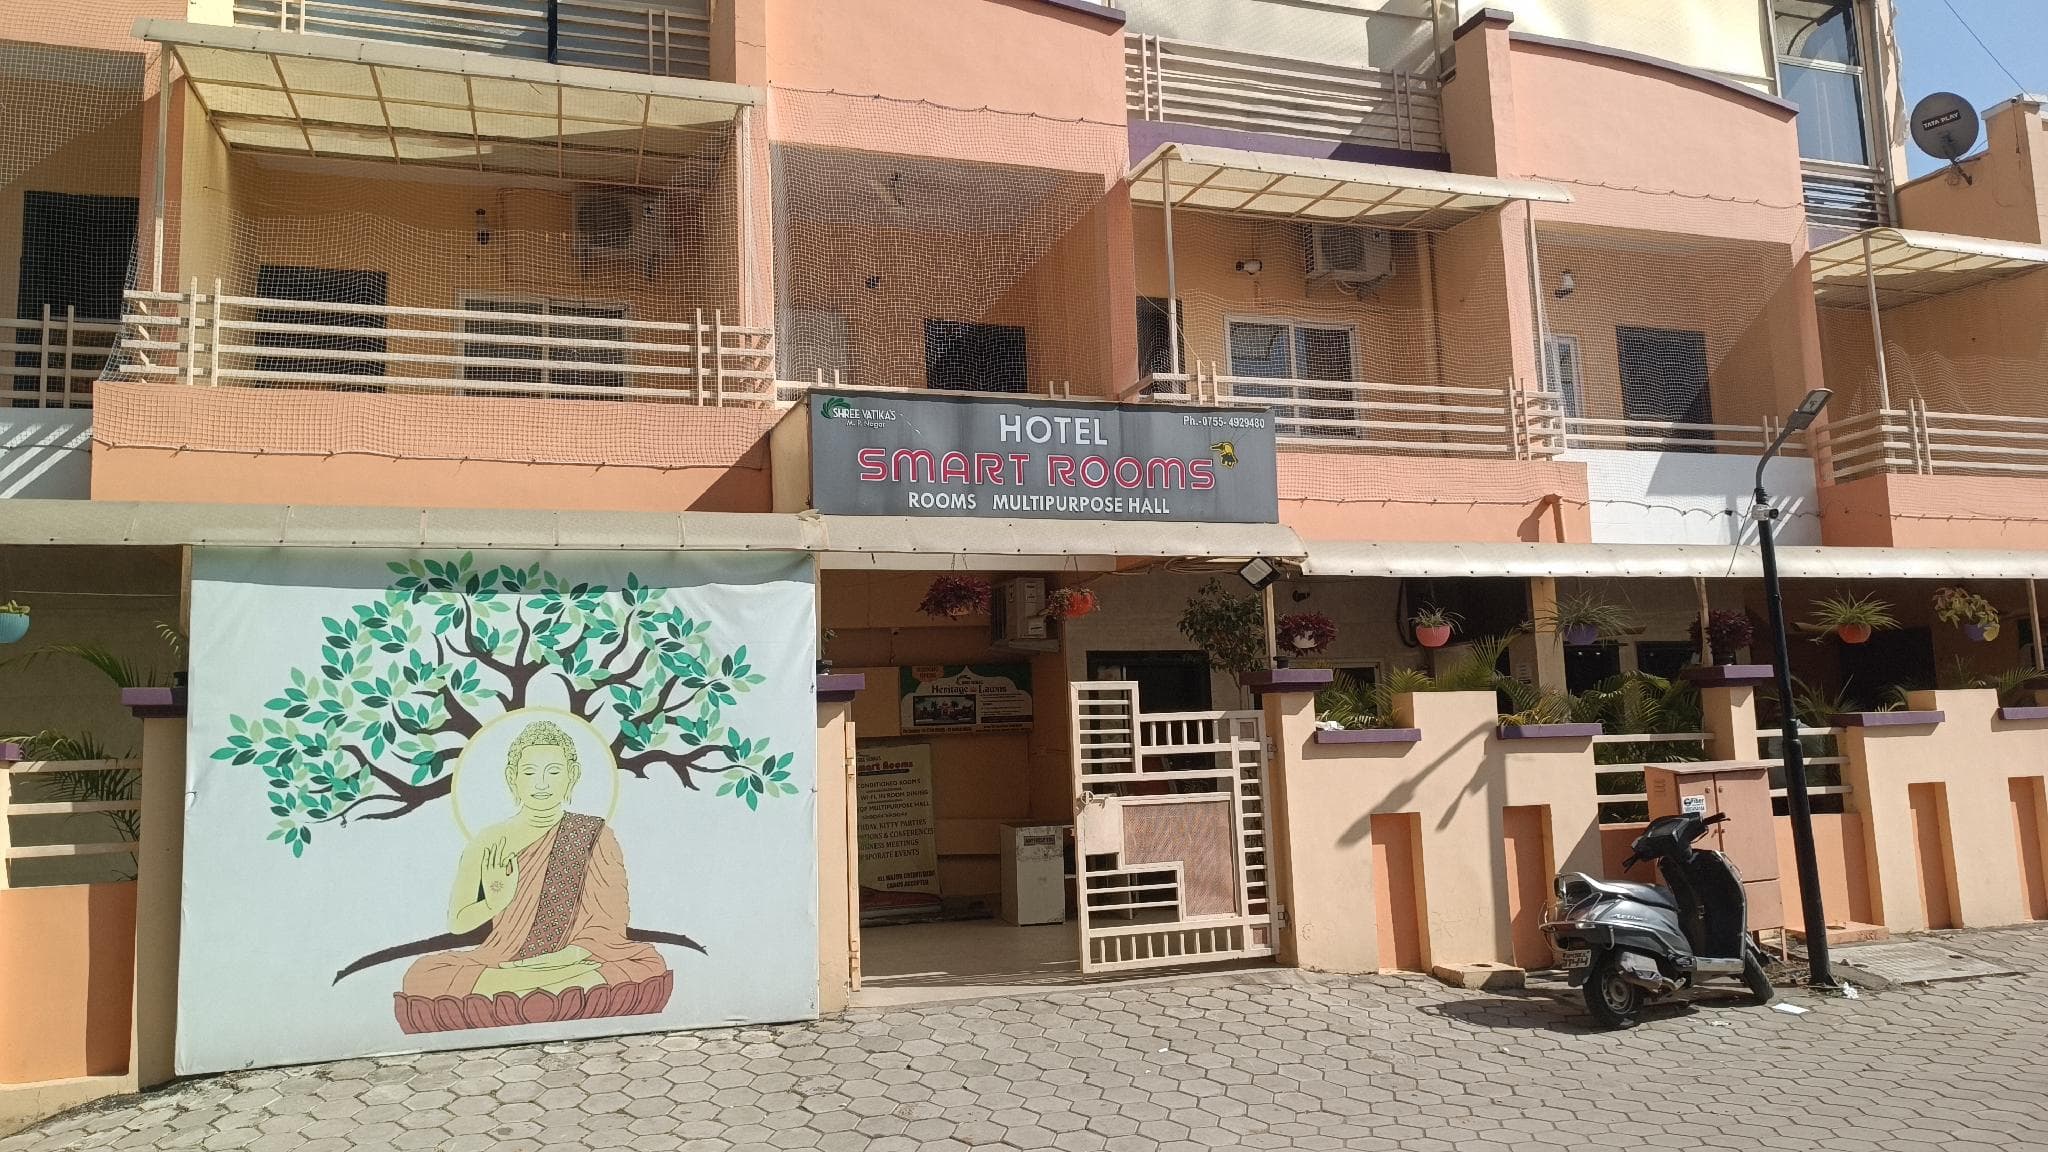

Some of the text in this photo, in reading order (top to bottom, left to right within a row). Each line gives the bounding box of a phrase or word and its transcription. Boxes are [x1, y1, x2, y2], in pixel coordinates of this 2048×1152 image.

[1923, 112, 1959, 128] TATA PLAY
[832, 408, 861, 418] SHREE
[864, 420, 886, 429] Nagar
[1229, 417, 1265, 429] 4929480
[1000, 414, 1108, 446] HOTEL
[857, 448, 1216, 490] SMART ROOMS
[908, 491, 1170, 515] ROOMS MULTIPURPOSE HALL
[931, 684, 969, 694] Heritage
[883, 761, 913, 769] Rooms
[869, 803, 912, 811] MULTIPURPOSE
[895, 849, 920, 858] EVENTS
